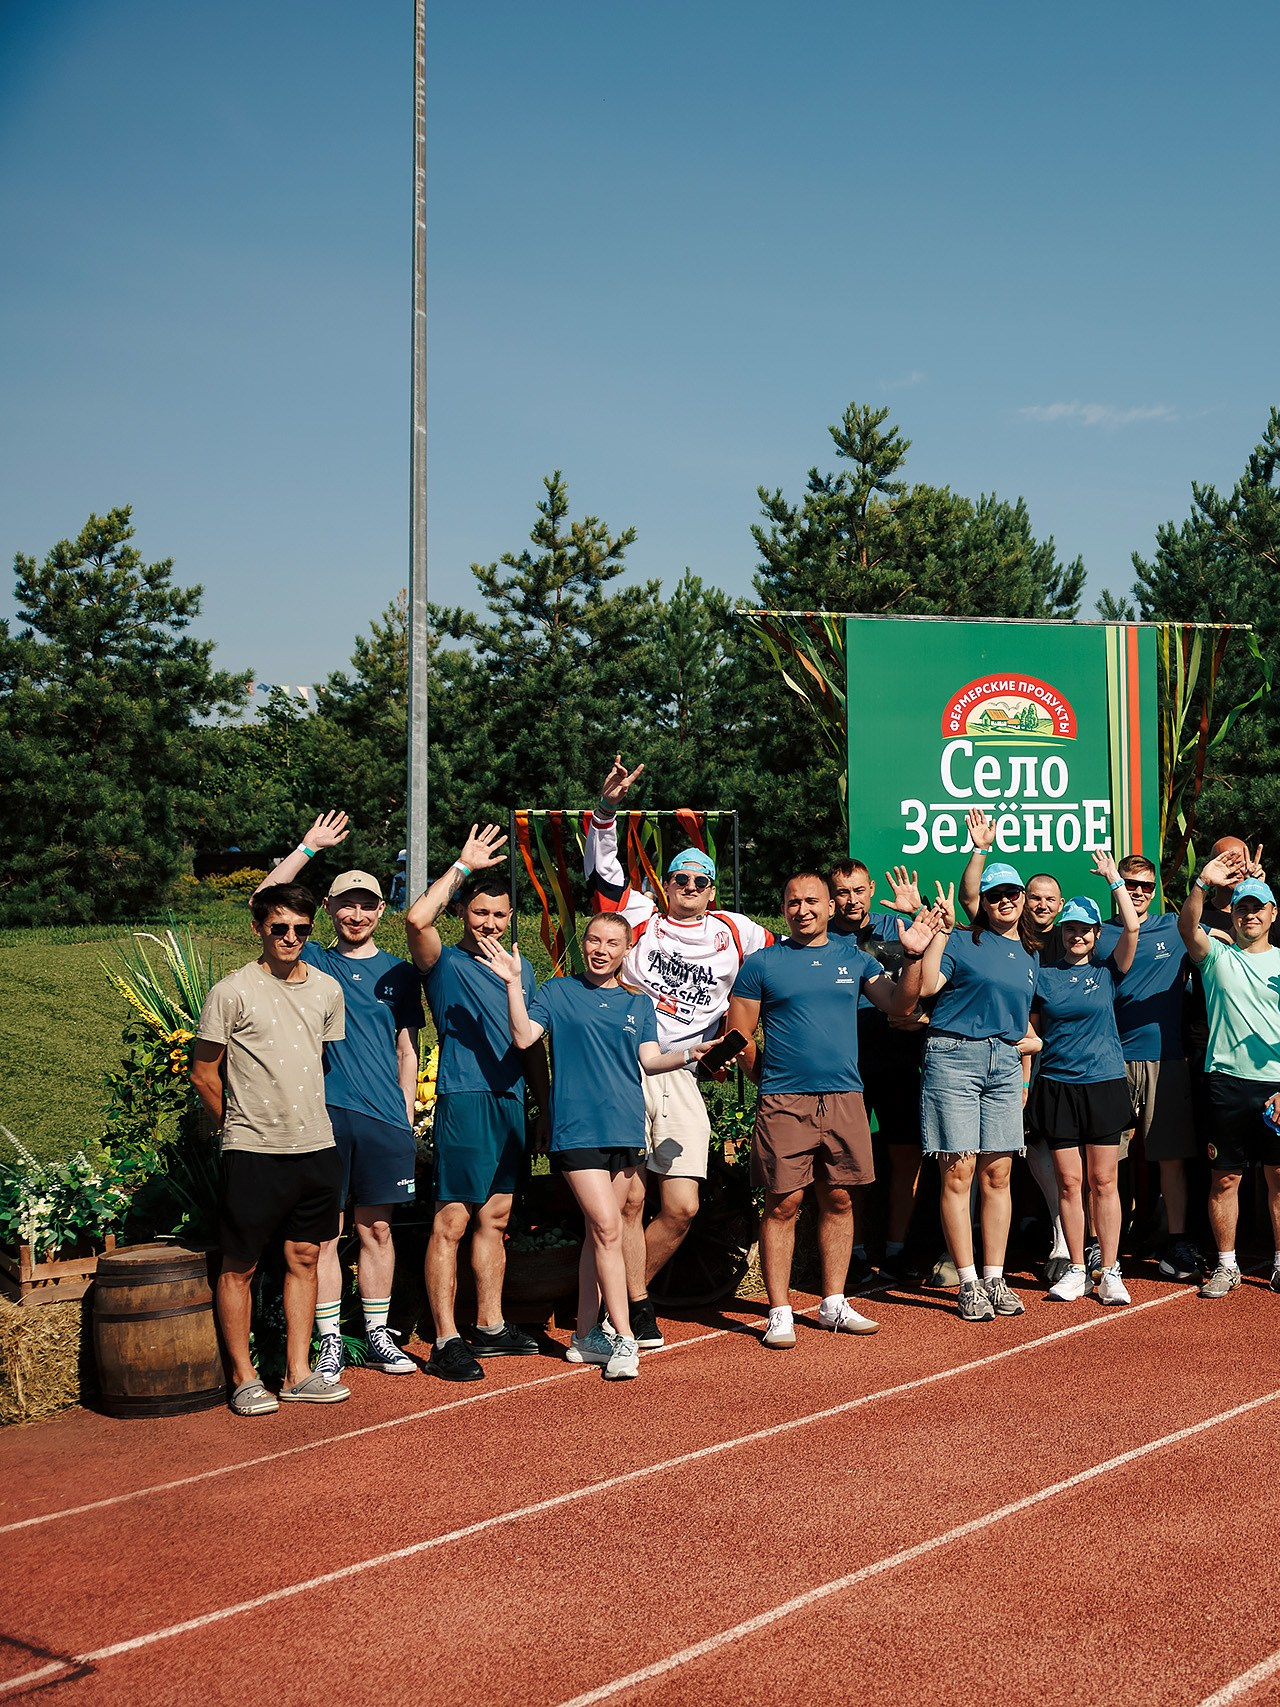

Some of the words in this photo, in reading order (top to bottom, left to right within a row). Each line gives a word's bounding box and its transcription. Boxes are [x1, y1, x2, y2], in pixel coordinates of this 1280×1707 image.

[949, 680, 1016, 732] ФЕРМЕРСКИЕ
[1018, 681, 1070, 733] ПРОДУКТЫ
[940, 739, 1069, 798] Село
